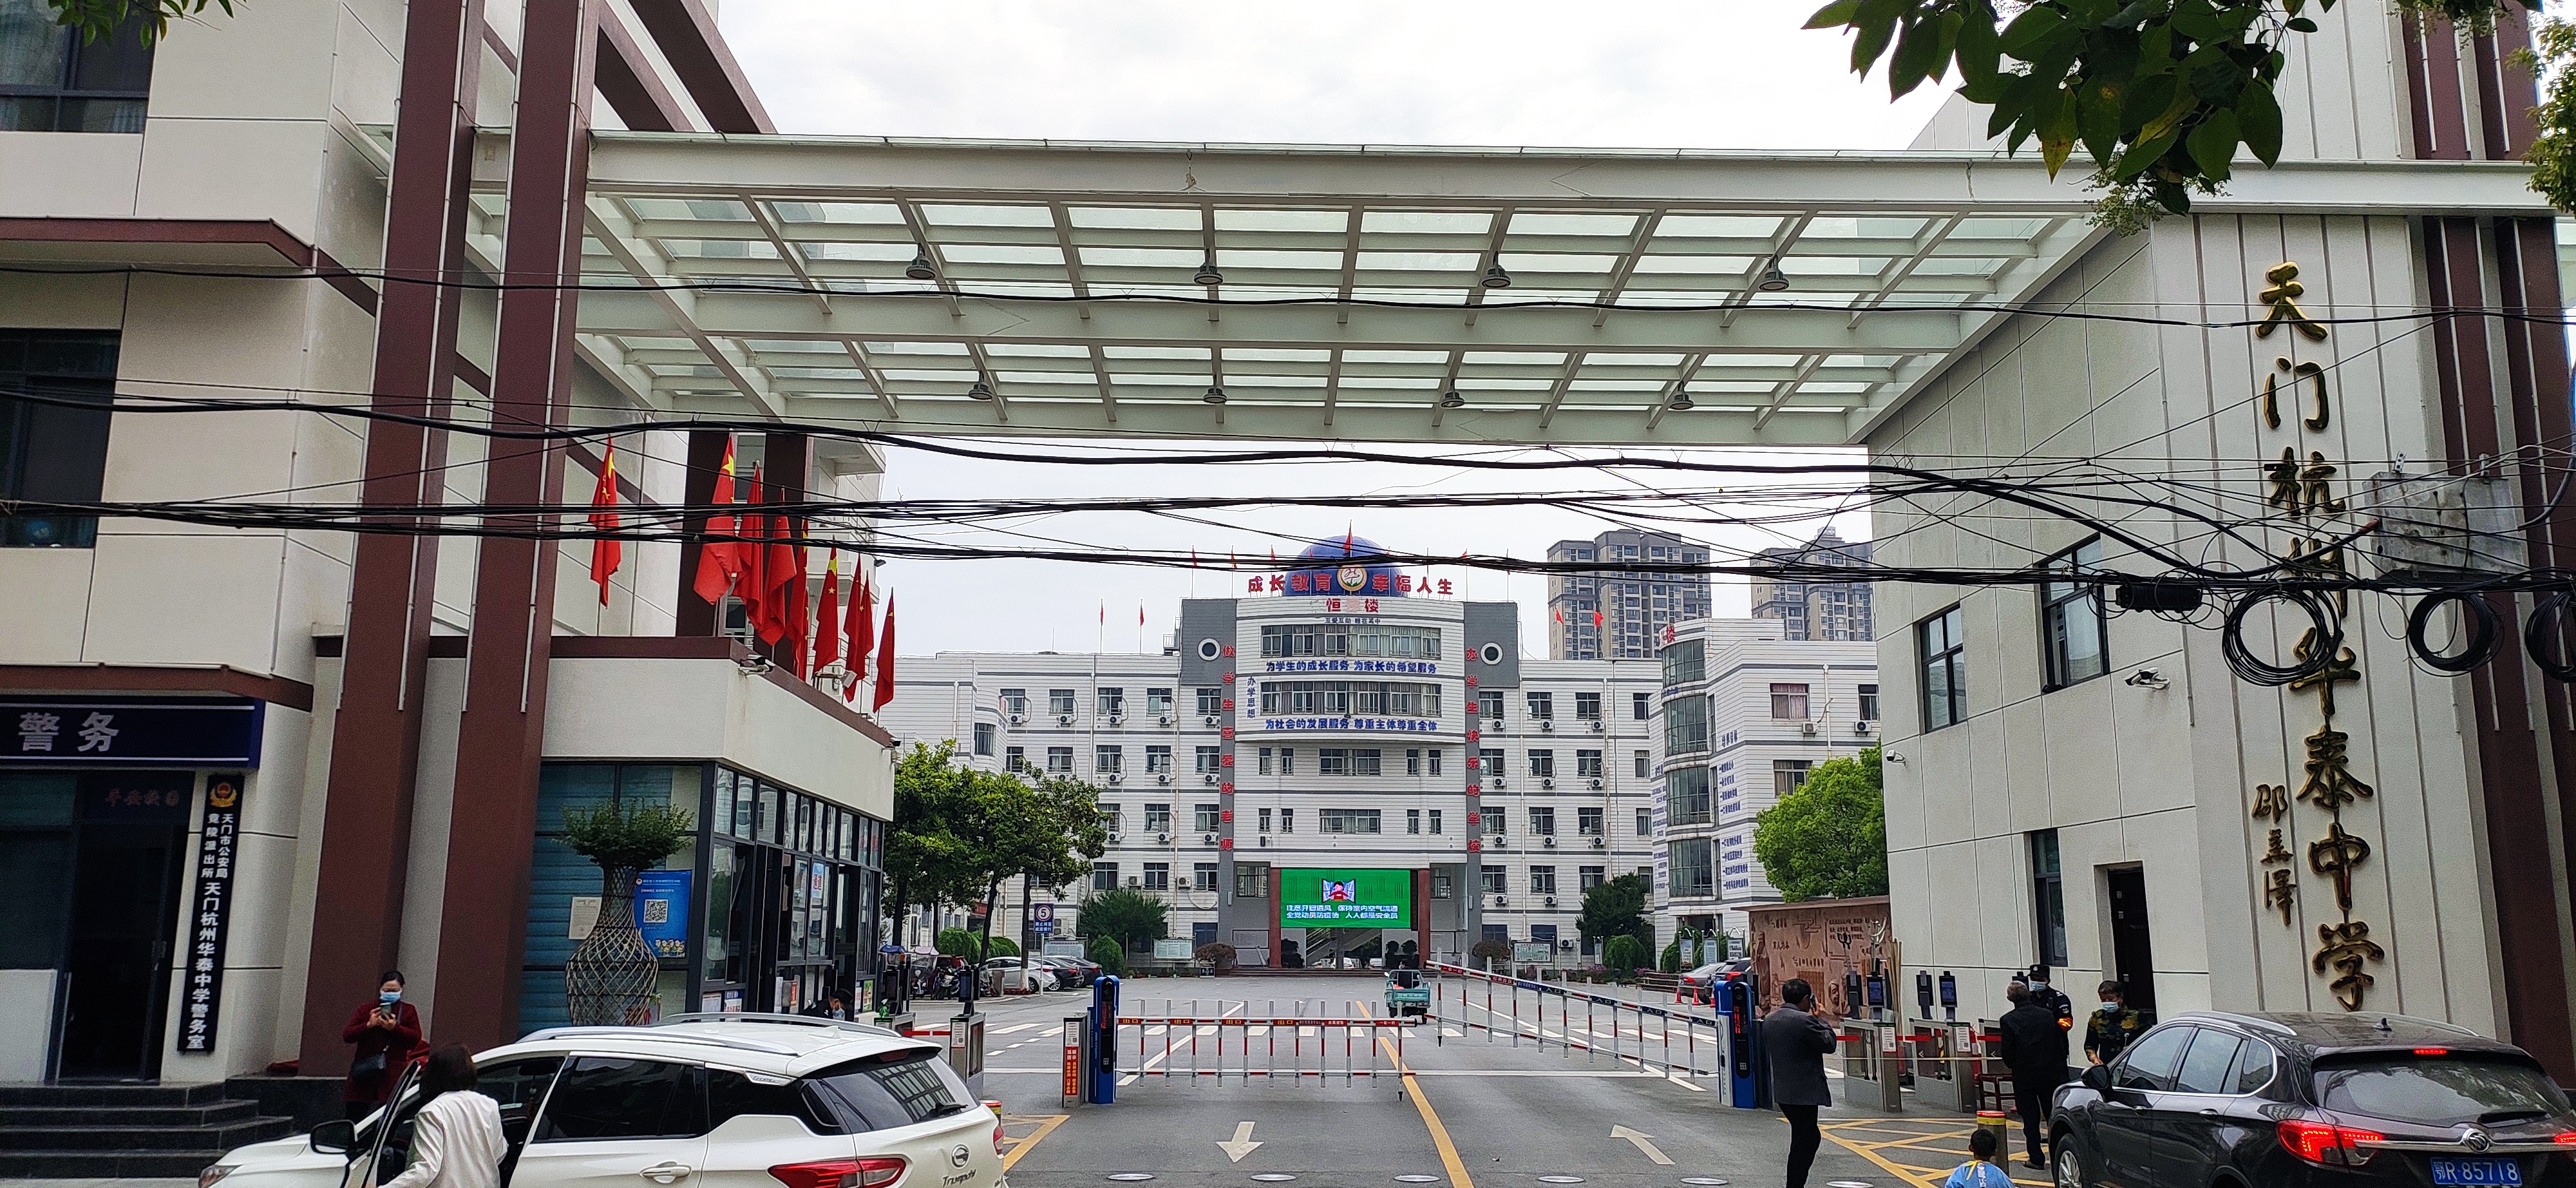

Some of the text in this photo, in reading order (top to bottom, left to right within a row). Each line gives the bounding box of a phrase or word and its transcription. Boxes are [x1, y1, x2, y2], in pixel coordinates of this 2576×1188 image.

[1248, 573, 1453, 595] 成长教育 幸福人生
[1265, 660, 1437, 674] 为学生的成长服务 为家长的希望服务
[1247, 676, 1256, 719] 办学思想
[18, 711, 120, 752] 警务
[1265, 718, 1438, 732] 为社会的发展服务 尊重主体尊重全体
[1220, 644, 1236, 852] 做学生喜爱的老师
[1466, 647, 1481, 853] 办学生快乐的学校
[200, 812, 220, 879] 竟陵派出所
[214, 813, 234, 879] 天门市公安局
[1040, 908, 1046, 917] 5
[186, 882, 221, 1049] 天门杭州华泰中学警务室
